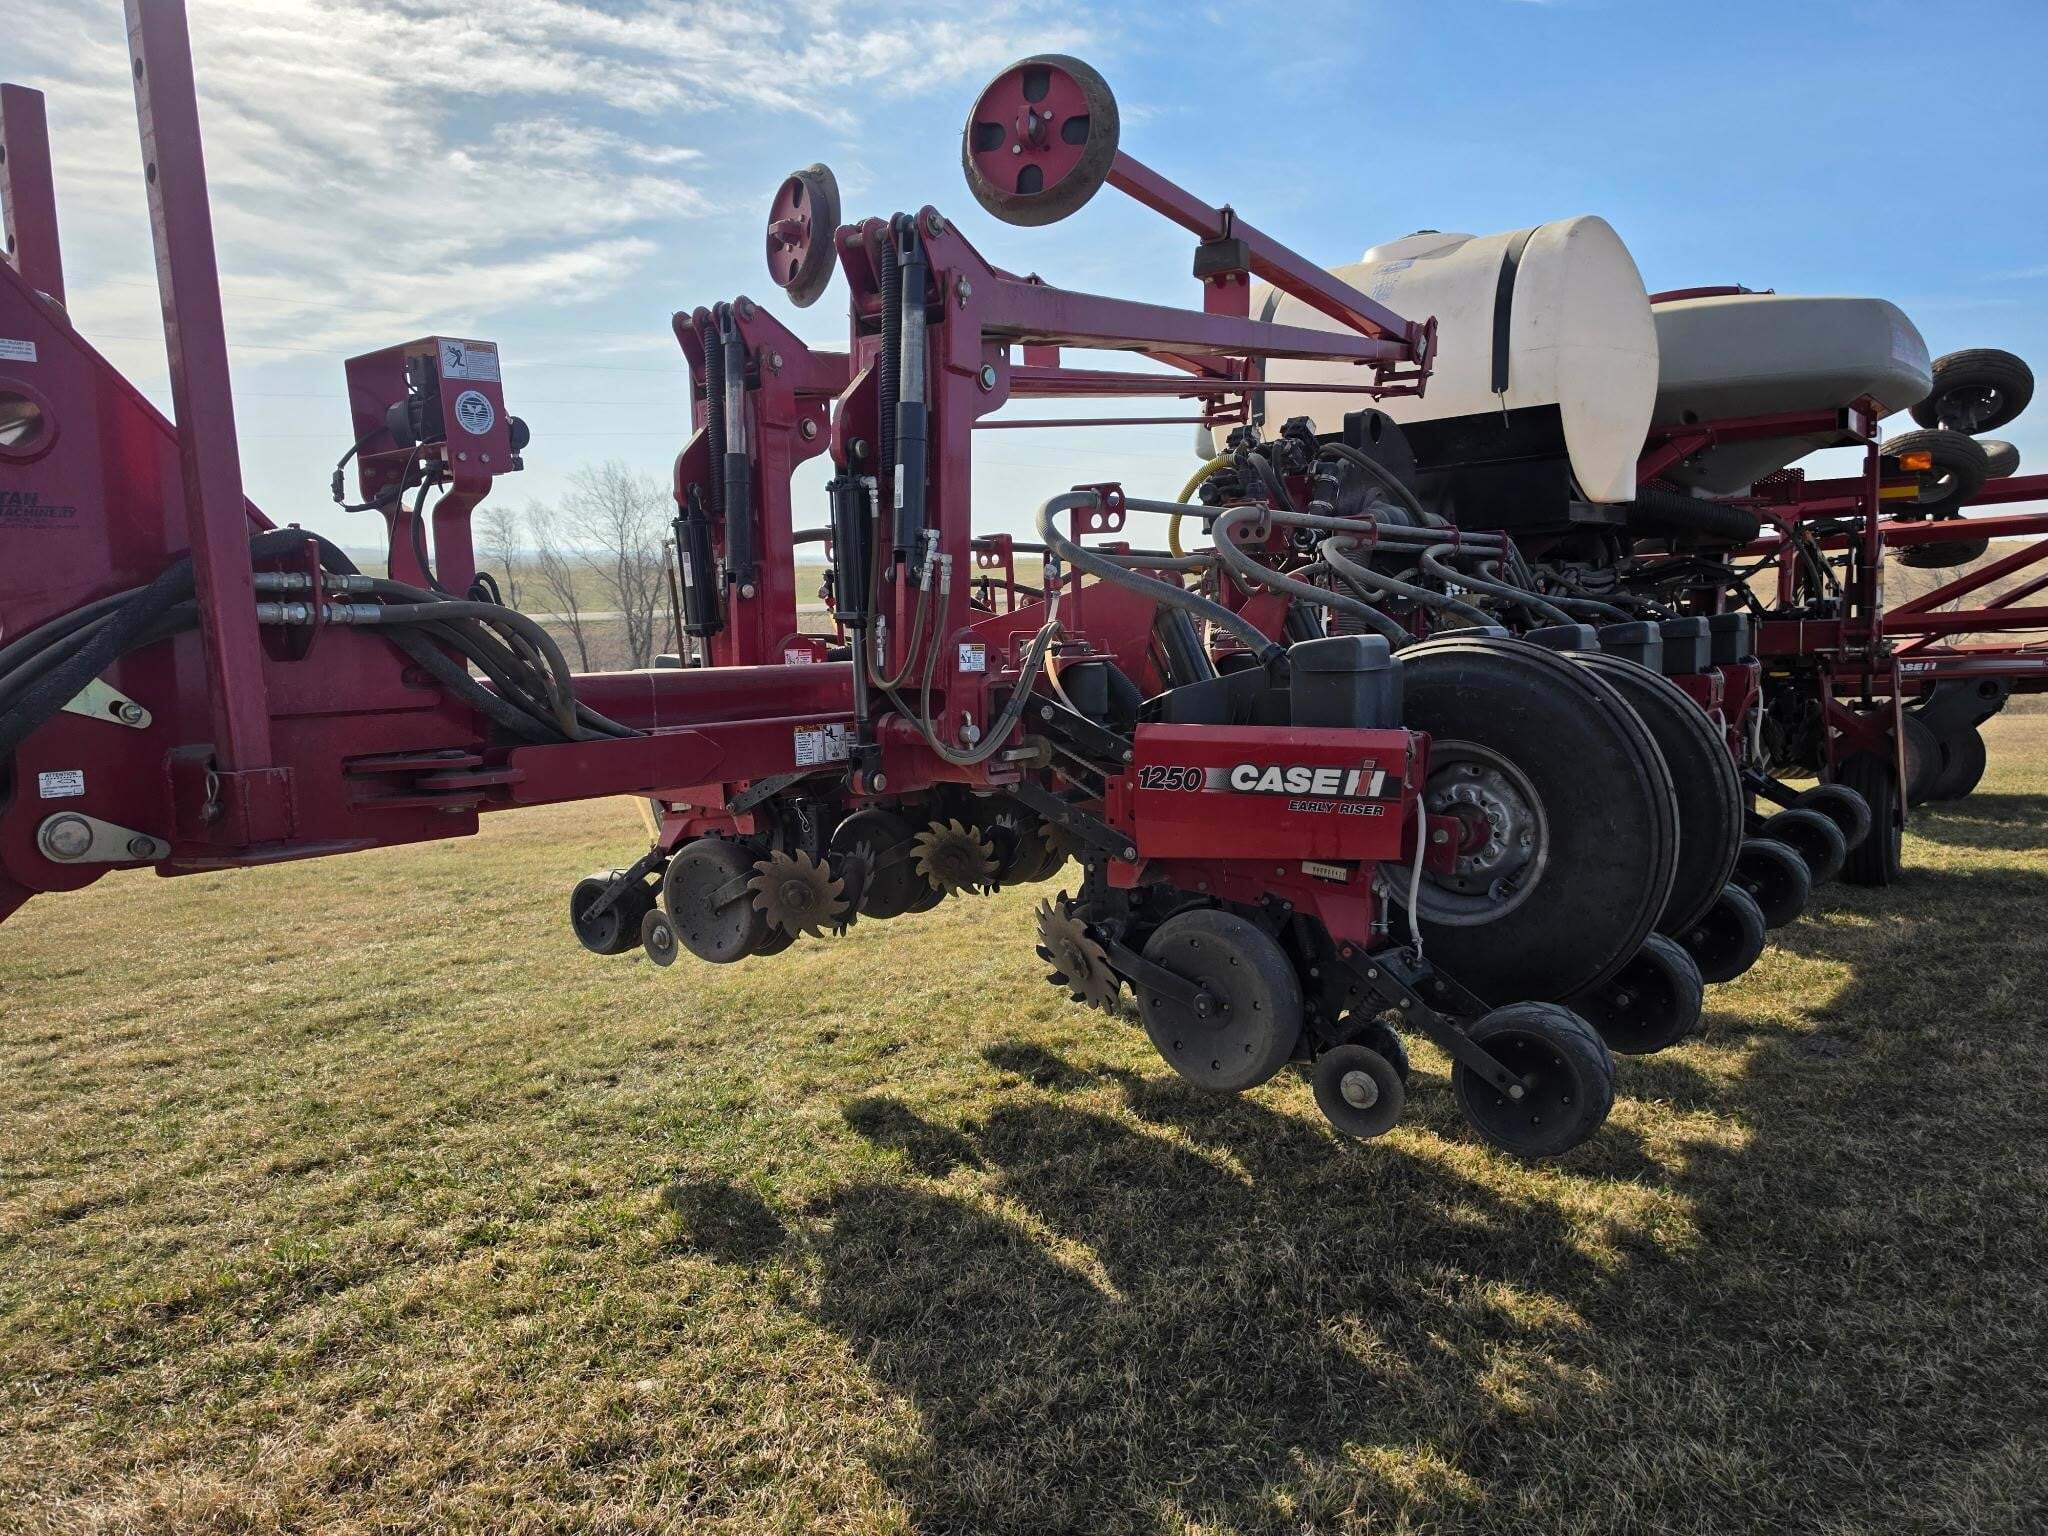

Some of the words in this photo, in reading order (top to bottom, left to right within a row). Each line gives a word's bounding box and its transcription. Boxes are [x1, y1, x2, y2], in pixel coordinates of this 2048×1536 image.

[0, 507, 76, 518] ACHINERY
[1138, 764, 1202, 793] 1250
[1230, 764, 1342, 794] CASE
[1288, 800, 1336, 813] EARLY
[1338, 803, 1385, 816] RISER
